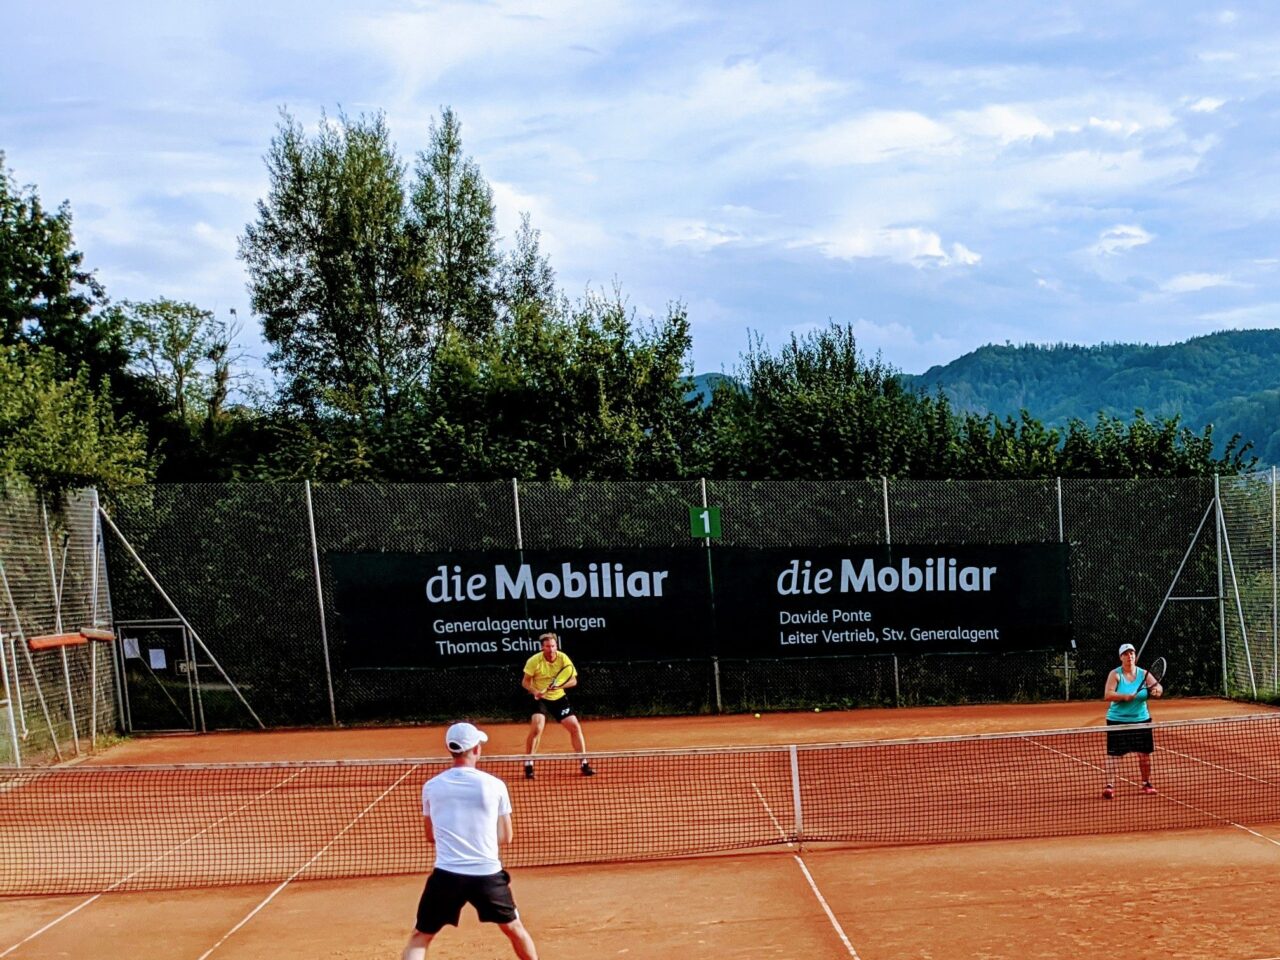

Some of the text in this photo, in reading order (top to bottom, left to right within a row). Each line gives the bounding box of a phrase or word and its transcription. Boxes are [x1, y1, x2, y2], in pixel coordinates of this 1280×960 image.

[700, 510, 710, 534] 1
[426, 562, 669, 603] die Mobiliar
[777, 557, 998, 595] die Mobiliar
[433, 615, 606, 634] Generalagentur Horgen
[779, 609, 872, 625] Davide Ponte
[780, 627, 999, 645] Leiter Vertrieb, Stv. Generalagent
[435, 639, 498, 655] Thomas
